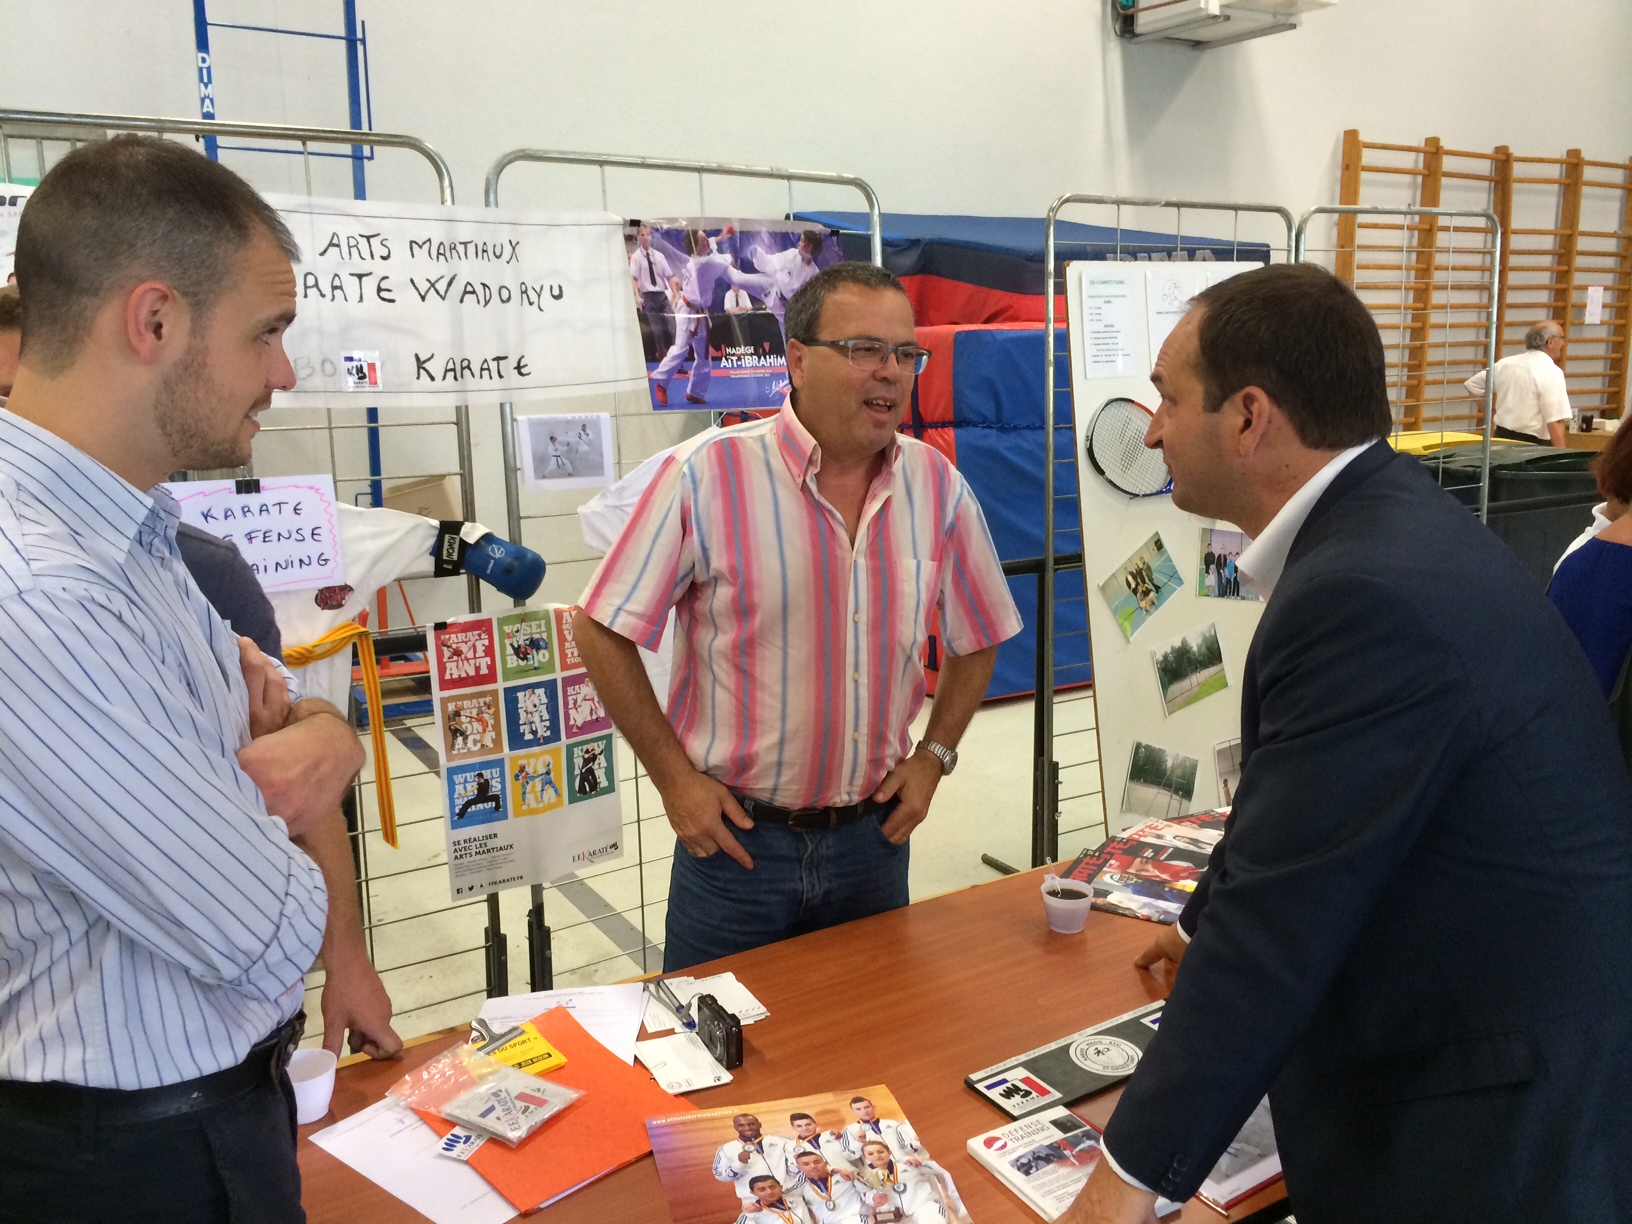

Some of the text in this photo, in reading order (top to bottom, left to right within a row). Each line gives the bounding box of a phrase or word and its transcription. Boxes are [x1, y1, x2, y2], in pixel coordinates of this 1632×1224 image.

[197, 52, 215, 114] DIMA
[319, 232, 520, 264] ARTS MARTIAUX
[303, 271, 396, 304] RATE
[414, 352, 532, 382] KARATE
[201, 501, 303, 523] KARATE
[444, 535, 457, 560] KWON
[452, 832, 499, 847] SE RÉALISER
[453, 841, 488, 854] AVEC LES
[453, 843, 514, 861] ARTS MARTIAUX
[508, 1036, 533, 1050] SPORT
[1001, 1119, 1043, 1139] DEFENSE
[1009, 1125, 1051, 1144] TRAINING
